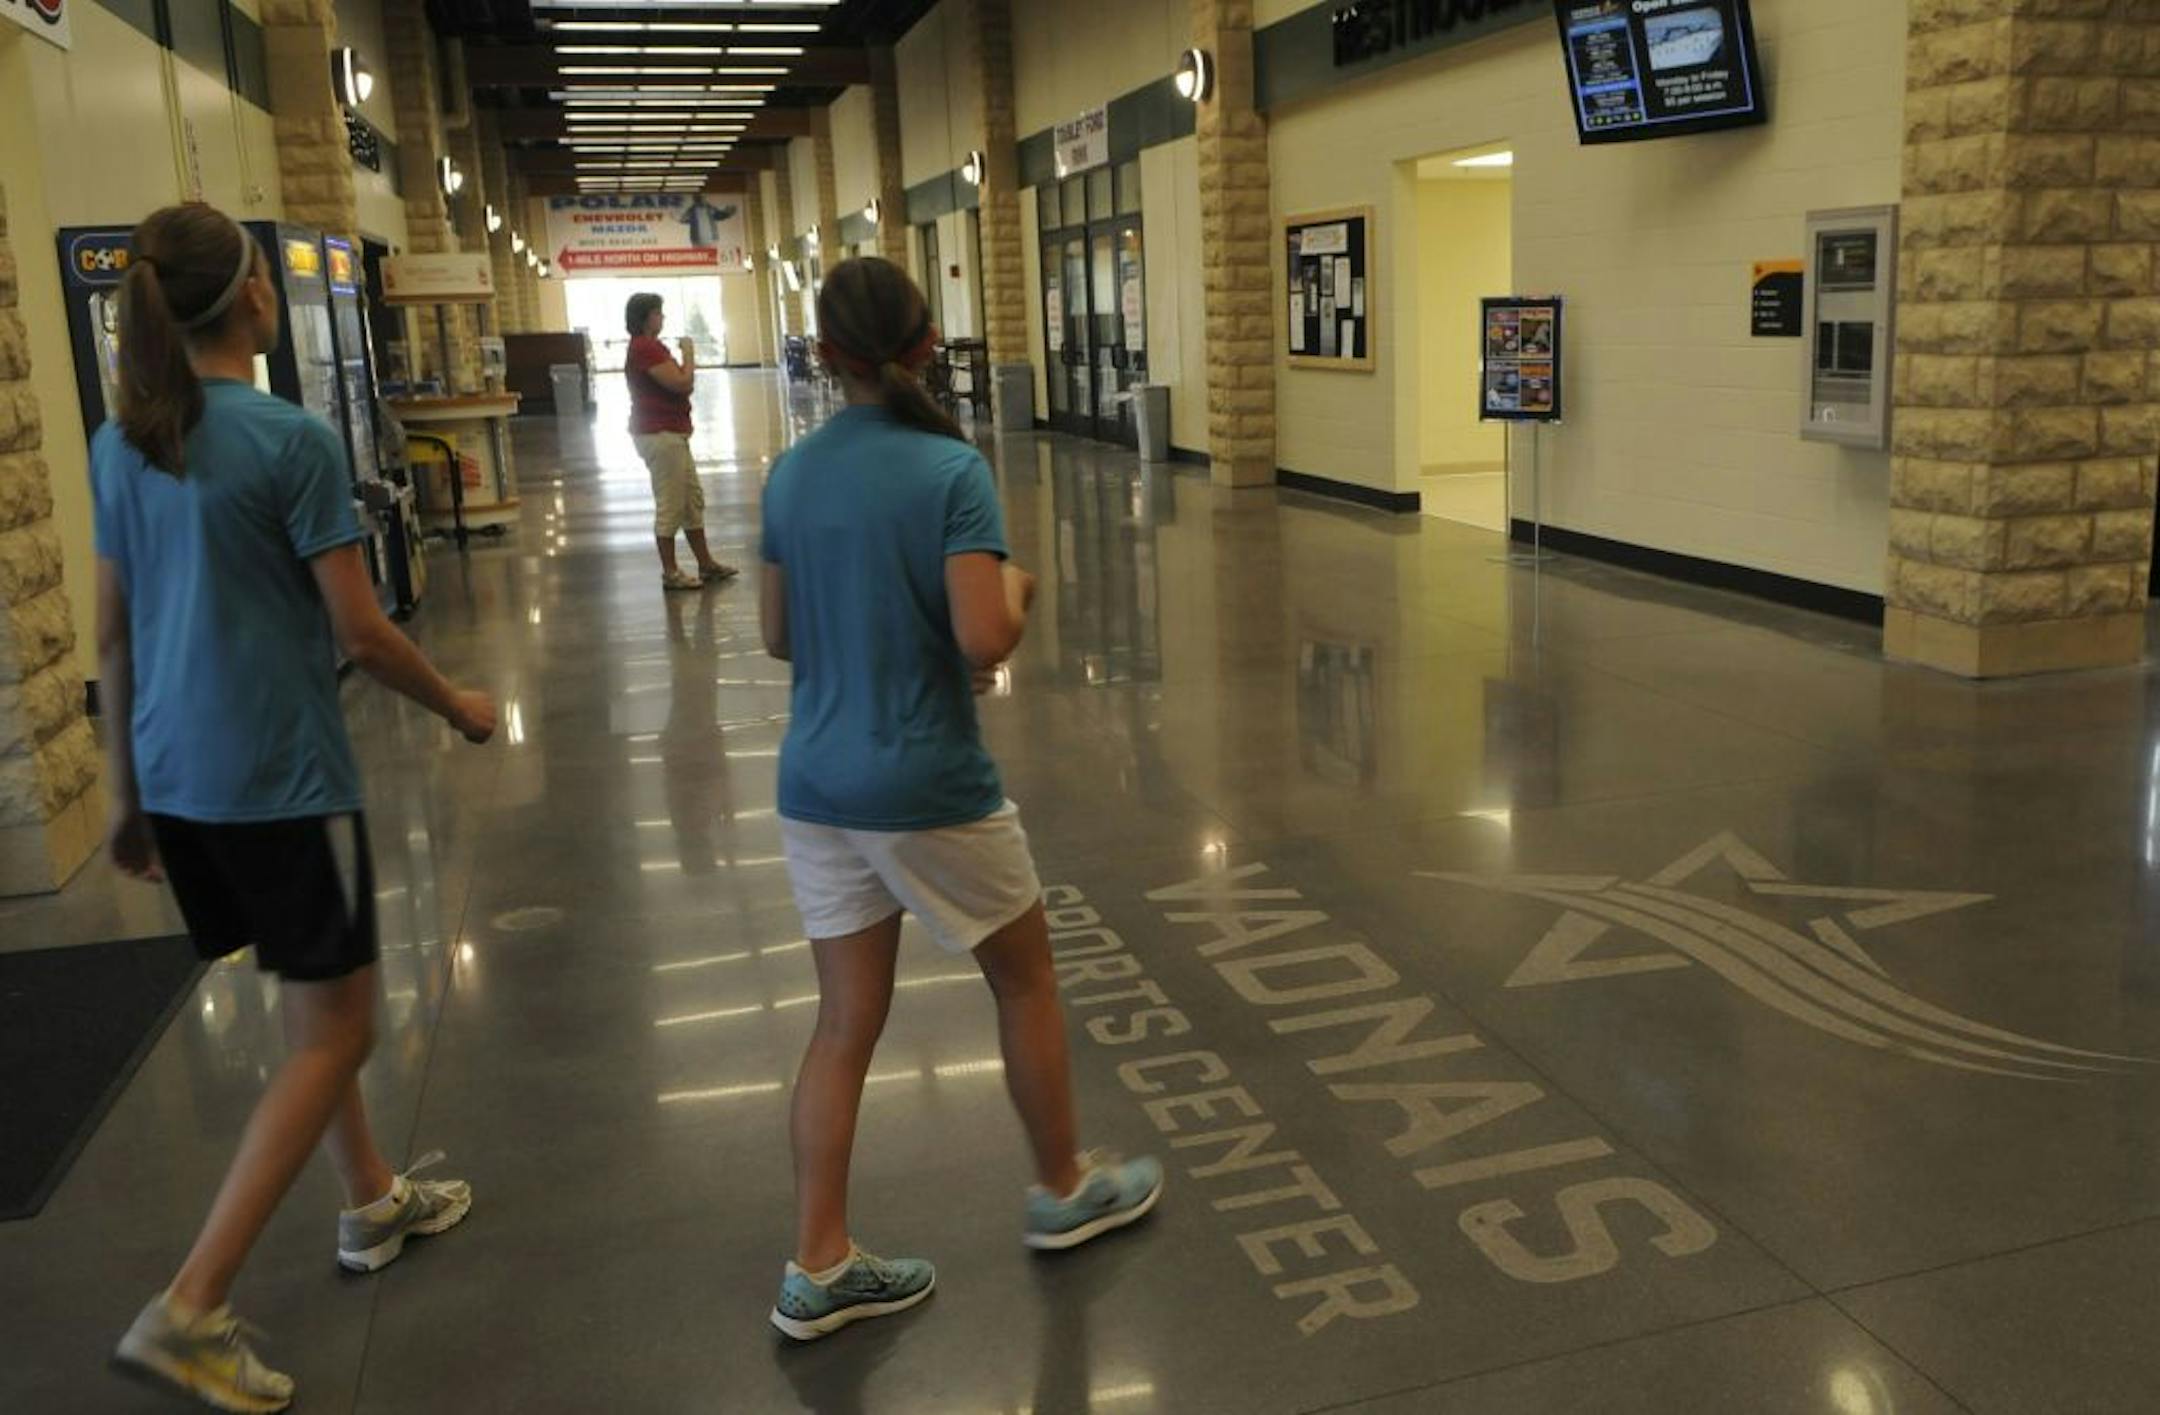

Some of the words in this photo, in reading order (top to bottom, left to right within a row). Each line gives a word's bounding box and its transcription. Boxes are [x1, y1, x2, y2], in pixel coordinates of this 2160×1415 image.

[551, 194, 683, 209] POLAR
[573, 213, 664, 223] CHEVROLET
[1146, 862, 1718, 1283] VADNAIS
[1117, 1050, 1421, 1336] CENTER
